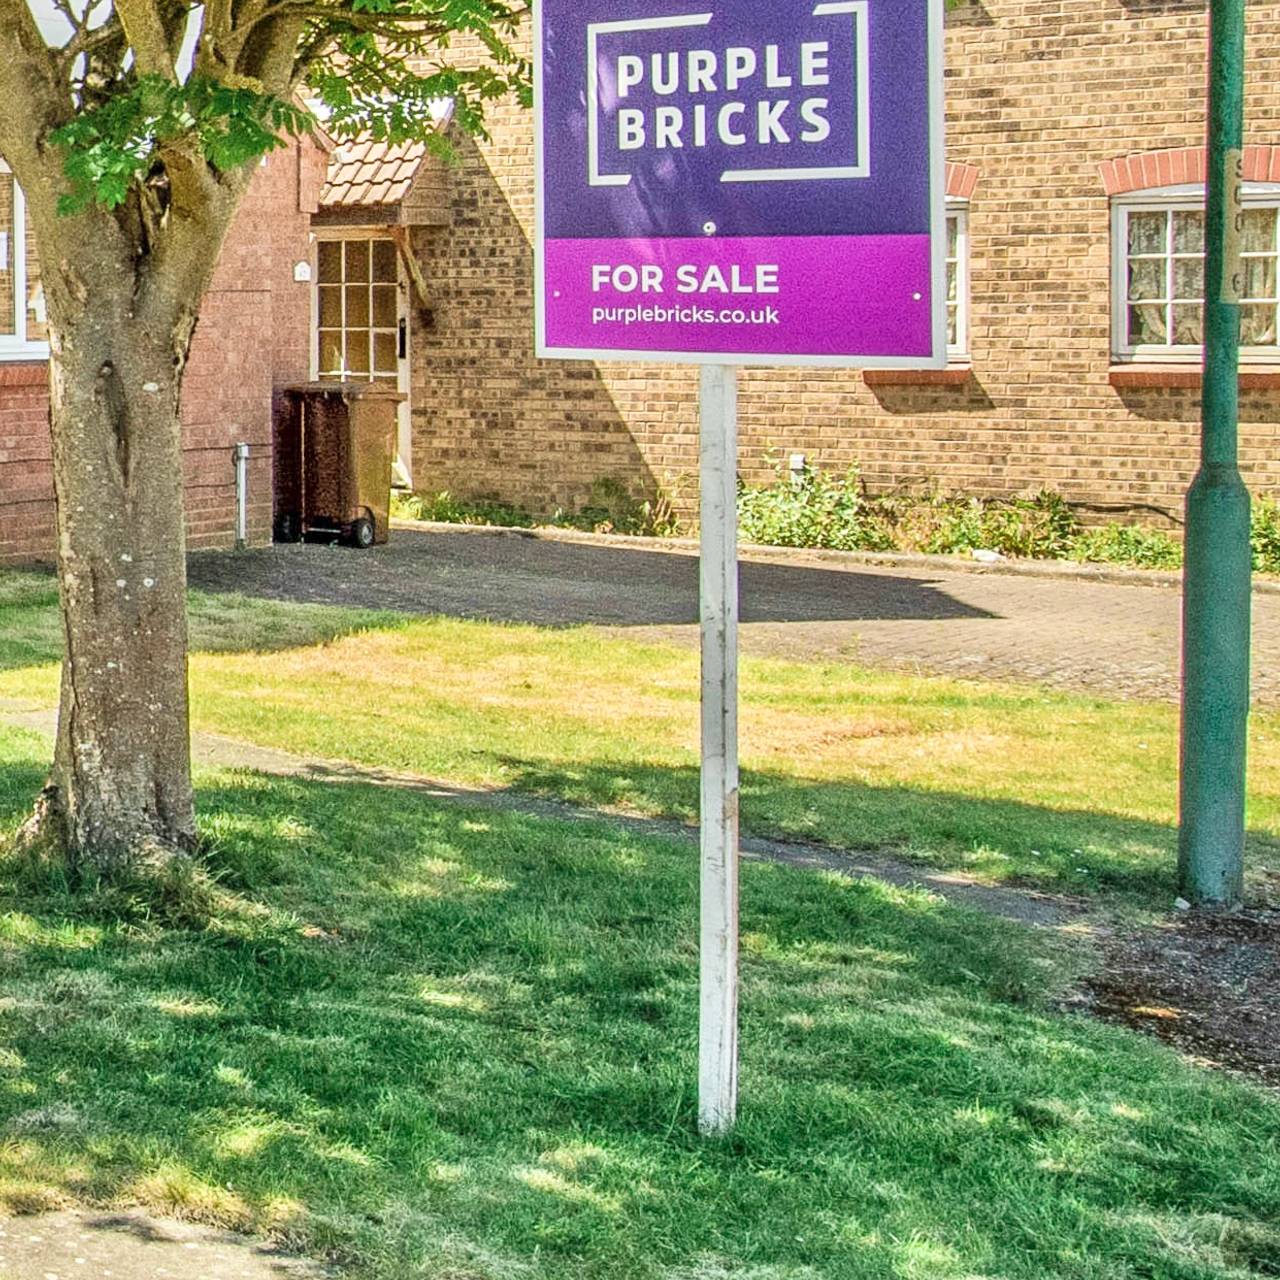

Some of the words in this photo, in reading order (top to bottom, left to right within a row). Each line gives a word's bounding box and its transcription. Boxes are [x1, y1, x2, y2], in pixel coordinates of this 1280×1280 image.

[617, 41, 830, 97] PURPLE
[618, 97, 832, 150] BRICKS
[592, 264, 664, 293] FOR
[676, 264, 780, 293] SALE
[592, 304, 780, 325] purplebricks.co.uk
